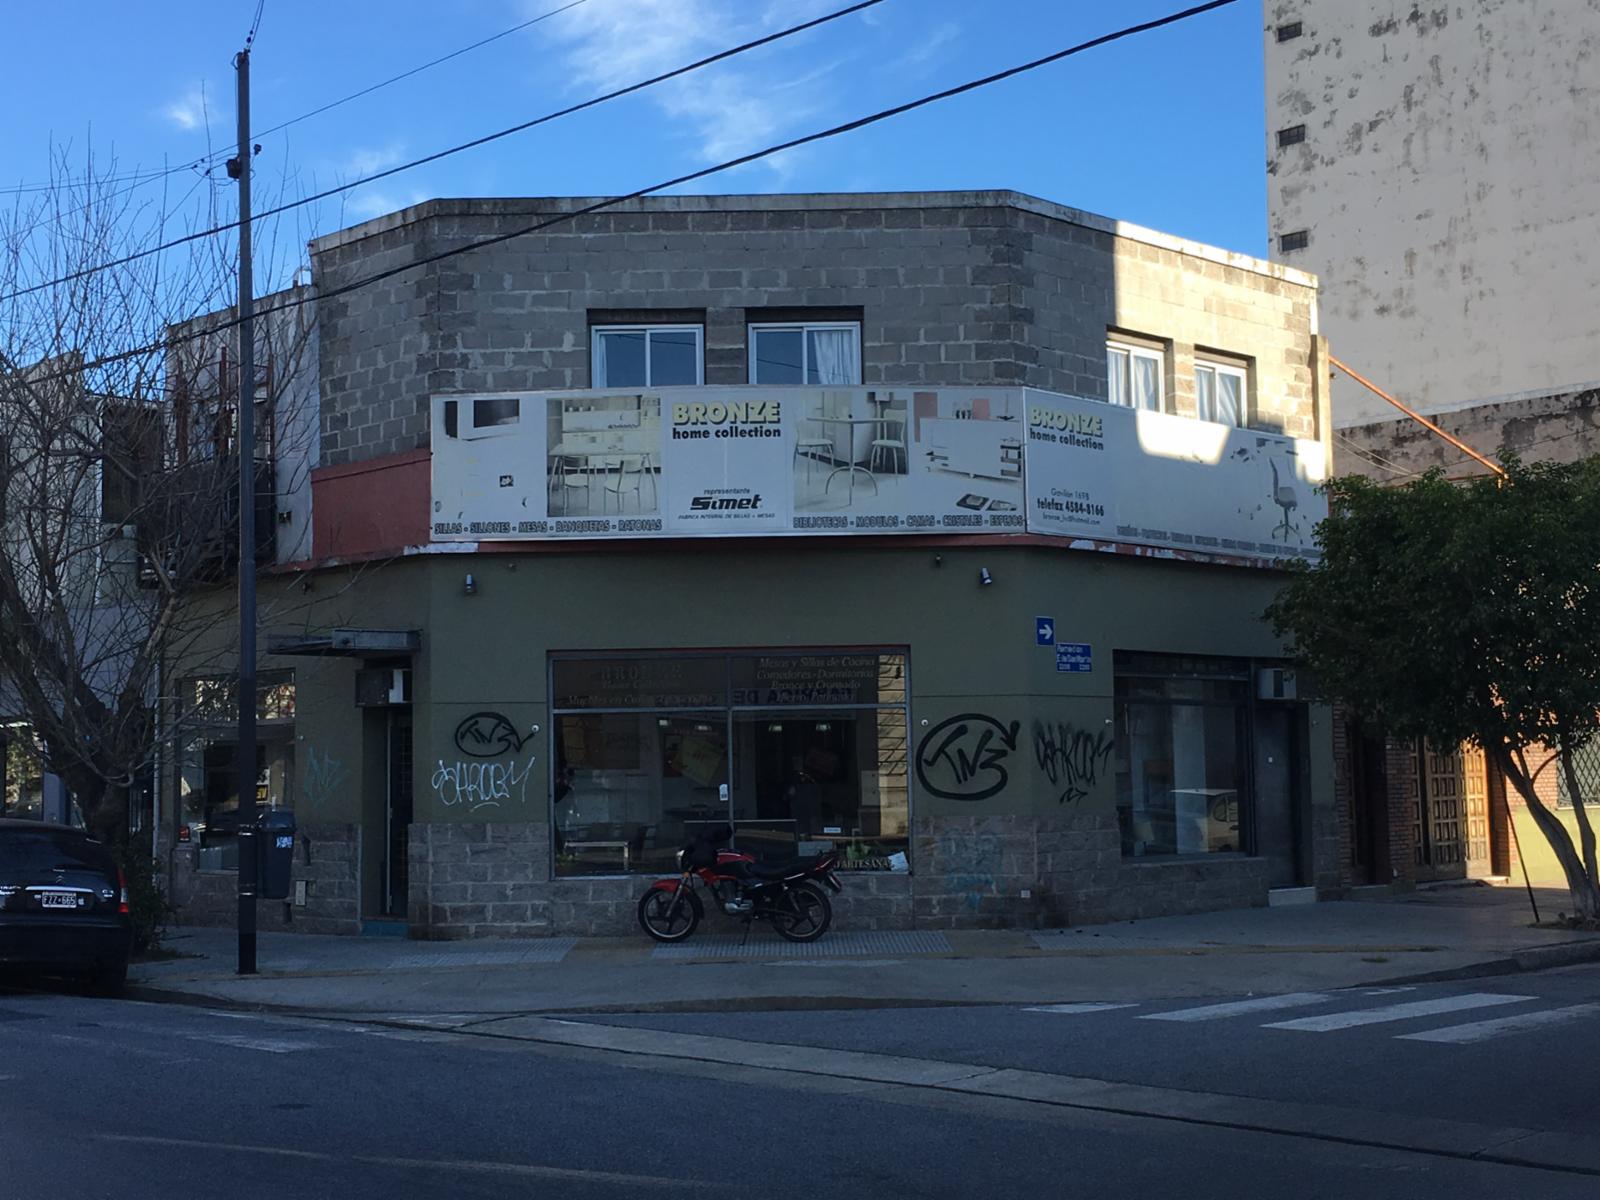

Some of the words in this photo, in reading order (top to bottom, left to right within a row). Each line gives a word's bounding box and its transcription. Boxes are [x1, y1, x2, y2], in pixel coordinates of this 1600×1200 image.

[671, 401, 781, 426] BRONZE
[1029, 405, 1103, 438] BRONZE
[672, 428, 711, 440] home
[715, 426, 781, 438] collection
[1029, 428, 1057, 443] home
[1059, 434, 1104, 450] collection
[703, 487, 751, 497] representante
[689, 494, 763, 511] Simet
[1037, 498, 1064, 512] telefax
[1065, 501, 1105, 517] 4584-8166
[434, 522, 463, 535] SILLAS
[470, 521, 511, 534] SILLONES
[518, 520, 548, 533] MESAS
[555, 520, 610, 532] BANQUETAS
[618, 519, 662, 531] RATONAS
[793, 516, 849, 529] BIBLIOTECAS
[906, 514, 936, 527] CAMAS
[942, 514, 983, 527] CRISTALES
[827, 657, 840, 667] de
